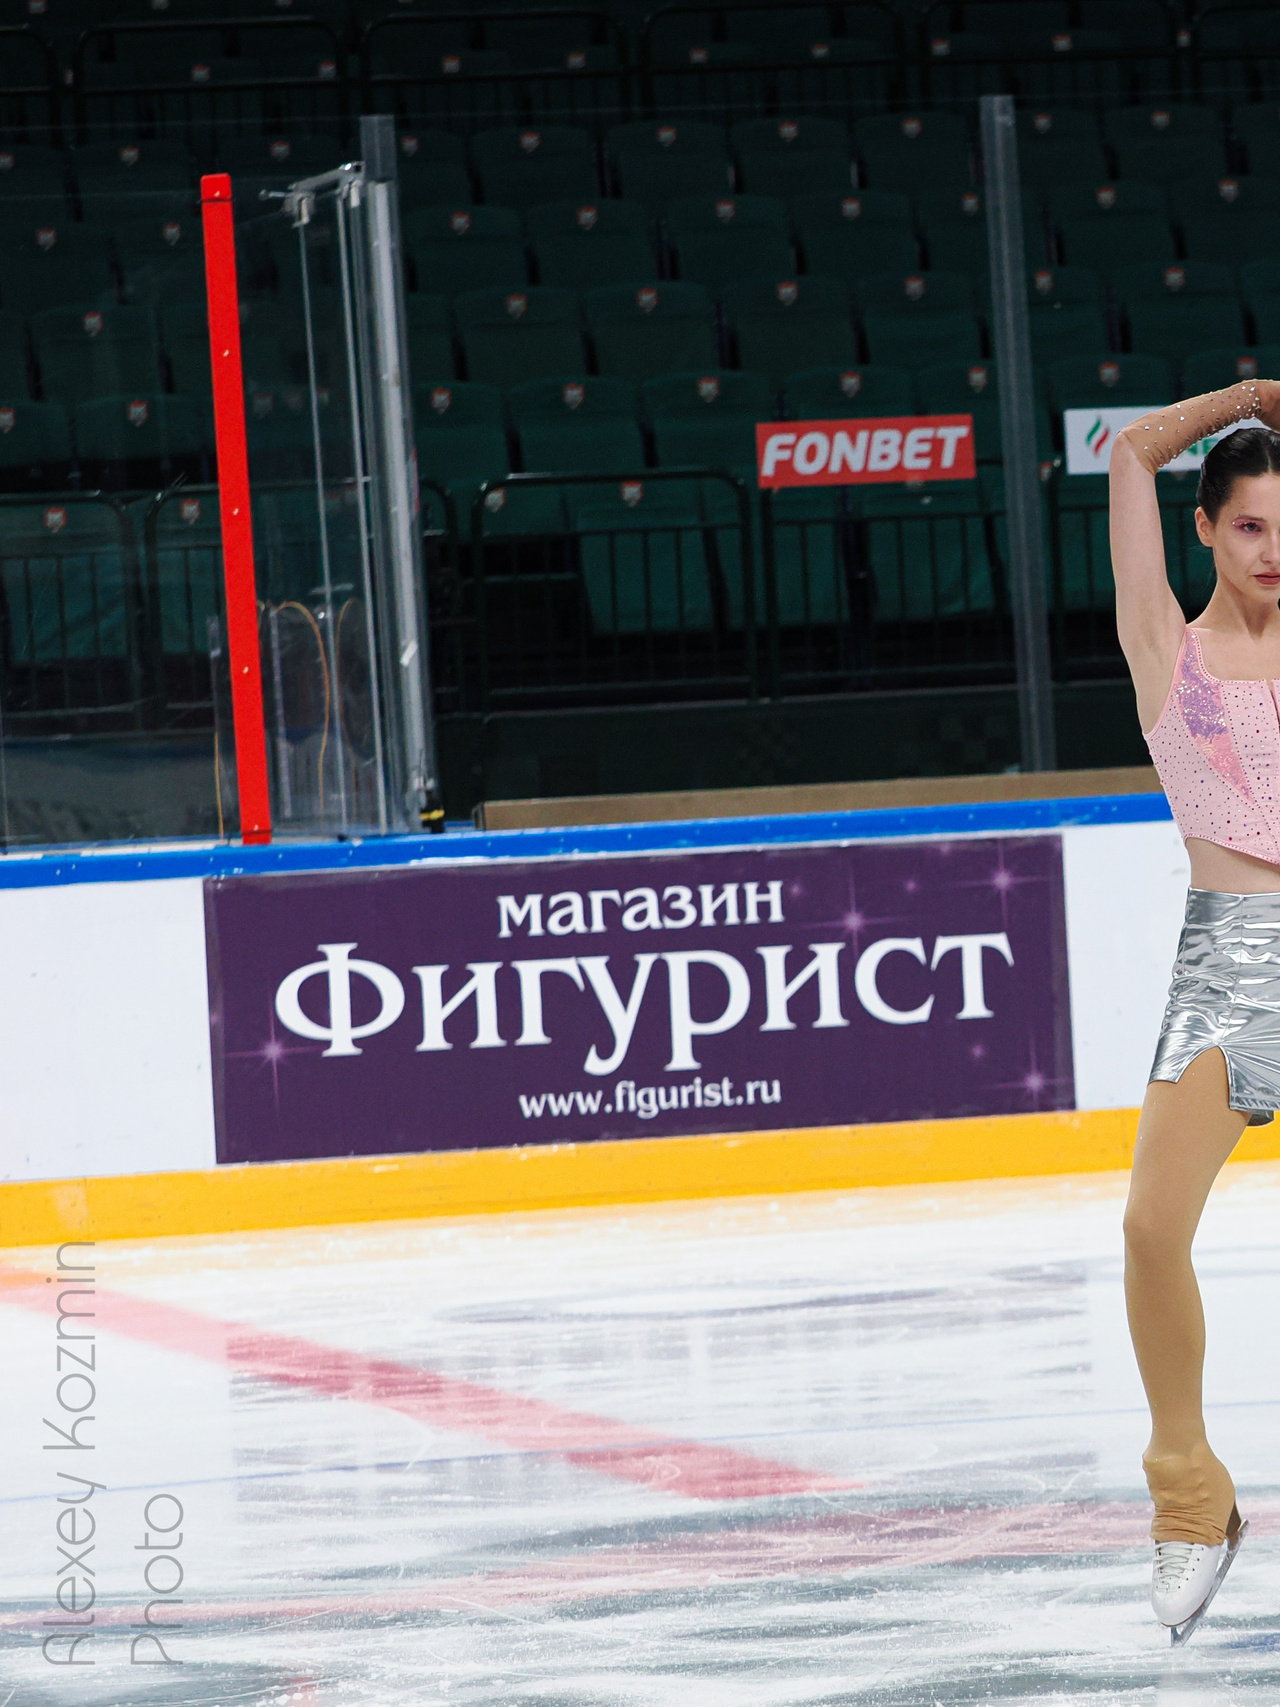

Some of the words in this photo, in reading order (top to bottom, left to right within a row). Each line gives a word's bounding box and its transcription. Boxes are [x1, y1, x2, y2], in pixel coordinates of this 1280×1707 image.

[761, 425, 969, 477] FONBET
[496, 880, 785, 939] магазин
[274, 931, 1015, 1076] Фигурист
[518, 1076, 783, 1120] www.figurist.ru
